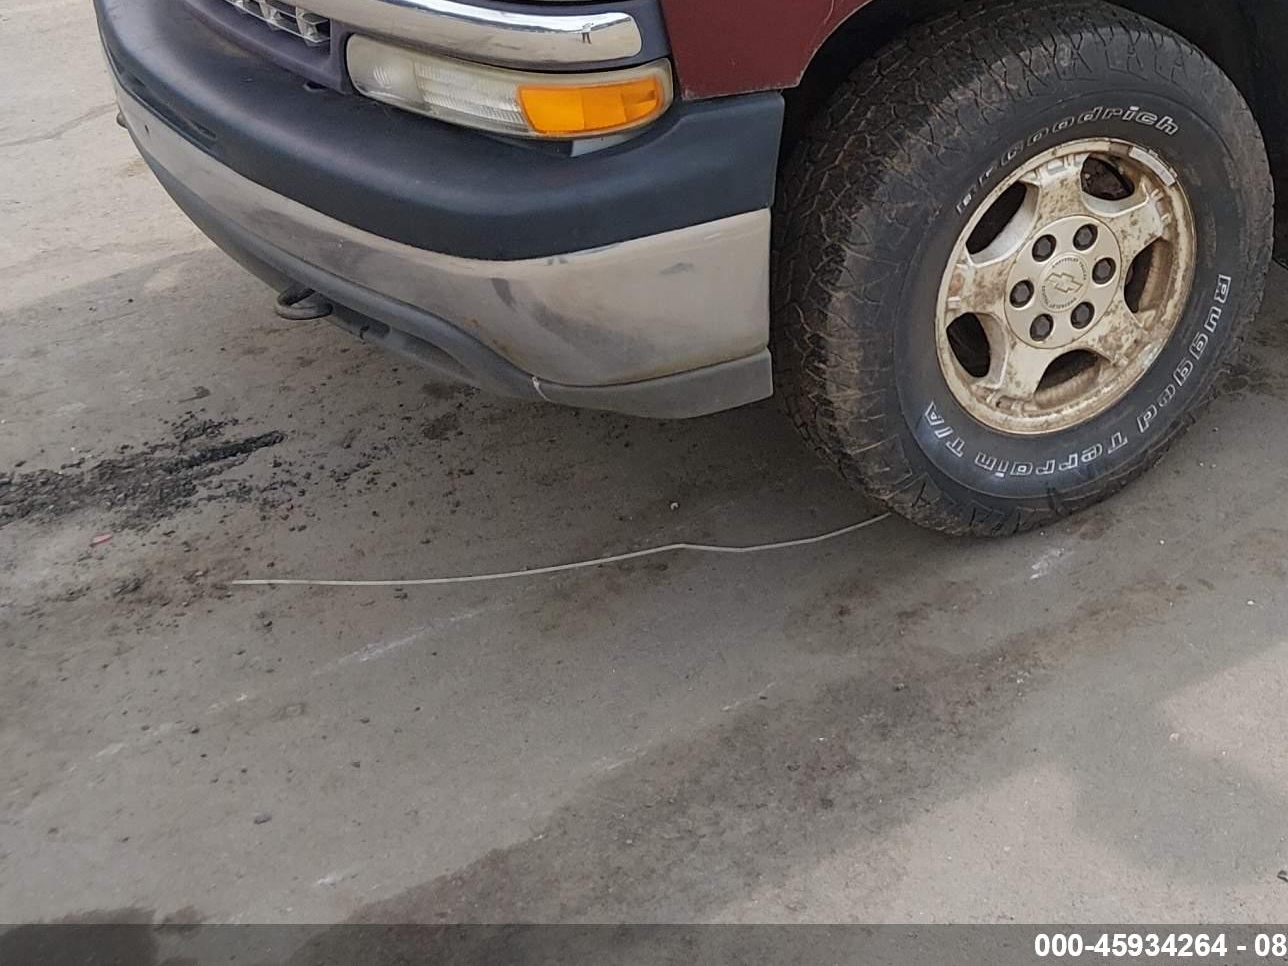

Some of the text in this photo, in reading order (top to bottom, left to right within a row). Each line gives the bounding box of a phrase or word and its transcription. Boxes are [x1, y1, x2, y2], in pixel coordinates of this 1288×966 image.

[1136, 273, 1233, 434] Rugged
[923, 401, 966, 458] T/A
[974, 431, 1129, 478] Terrain
